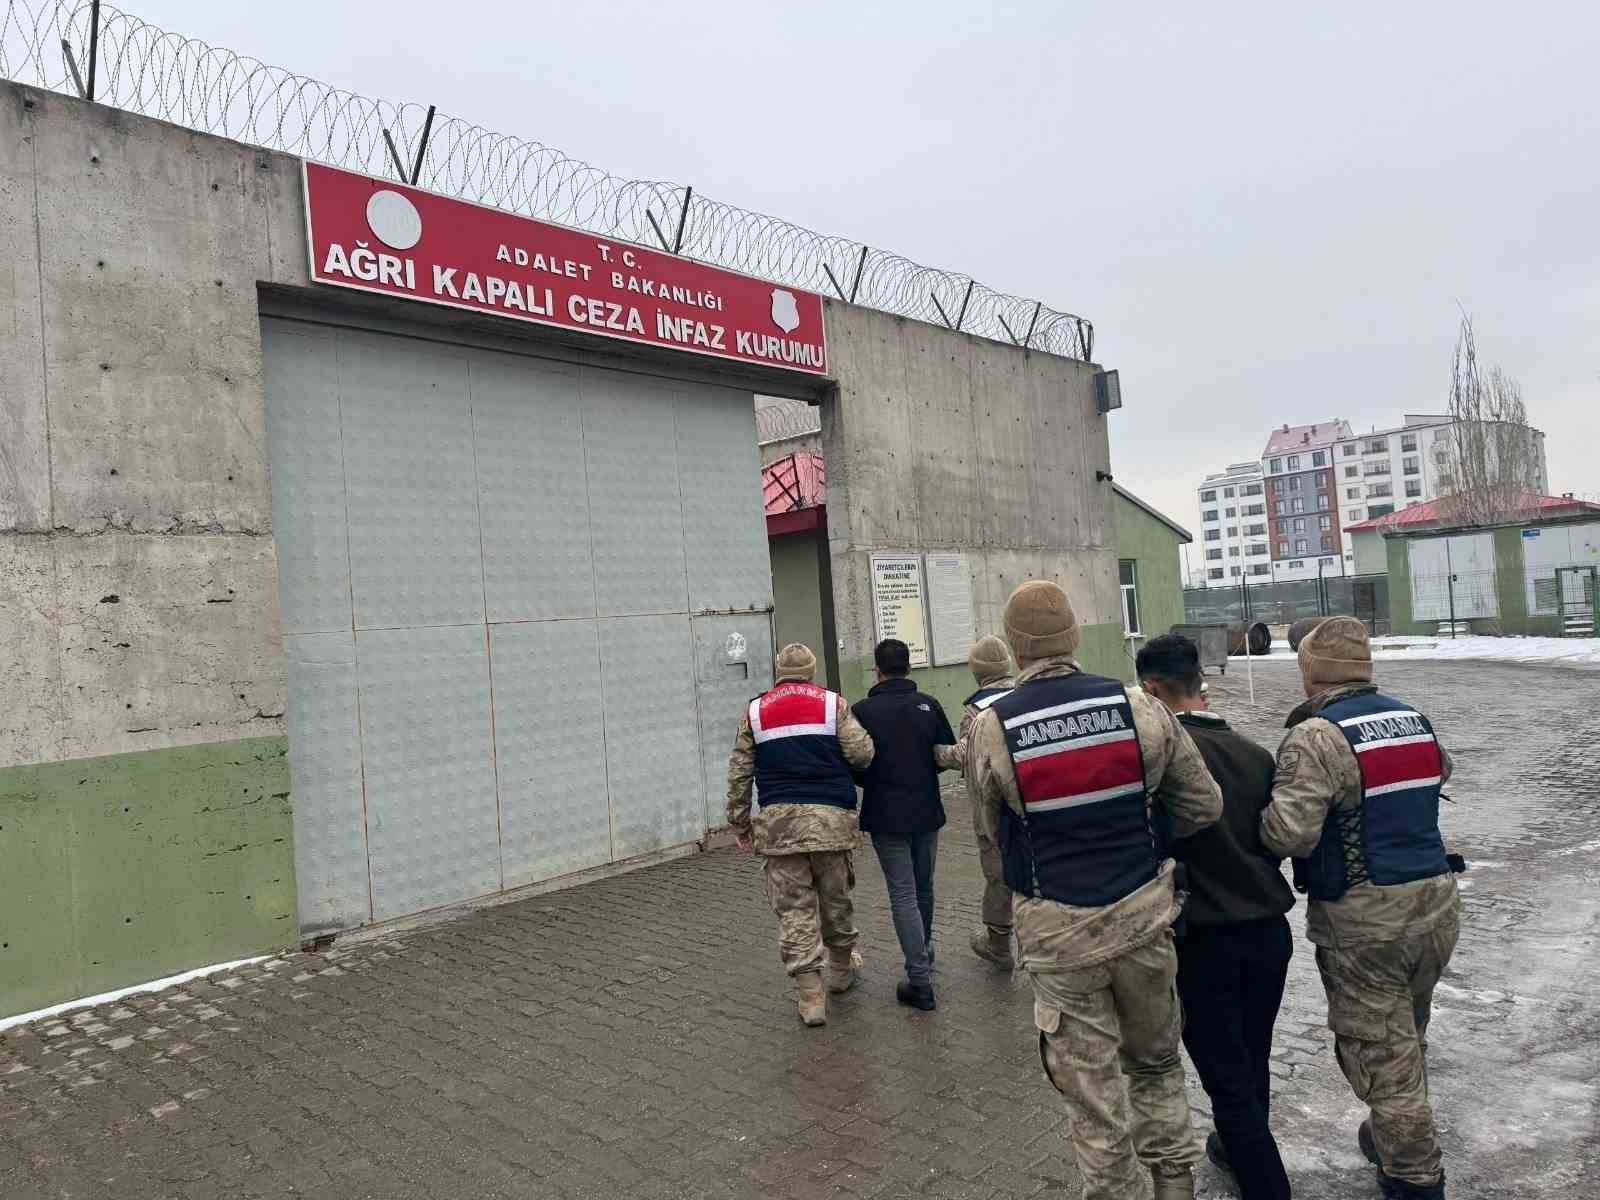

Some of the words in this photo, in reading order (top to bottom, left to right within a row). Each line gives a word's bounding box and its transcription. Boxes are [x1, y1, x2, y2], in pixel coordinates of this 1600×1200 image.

[495, 243, 593, 281] ADALET
[611, 271, 723, 312] BAKANLIĞI
[598, 243, 613, 263] T.
[622, 250, 642, 269] C.
[323, 239, 417, 290] AĞRI
[432, 264, 555, 317] KAPALI
[567, 293, 646, 335] CEZA
[656, 308, 727, 351] İNFAZ
[736, 329, 826, 369] KURUMU
[1016, 708, 1126, 747] JANDARMA
